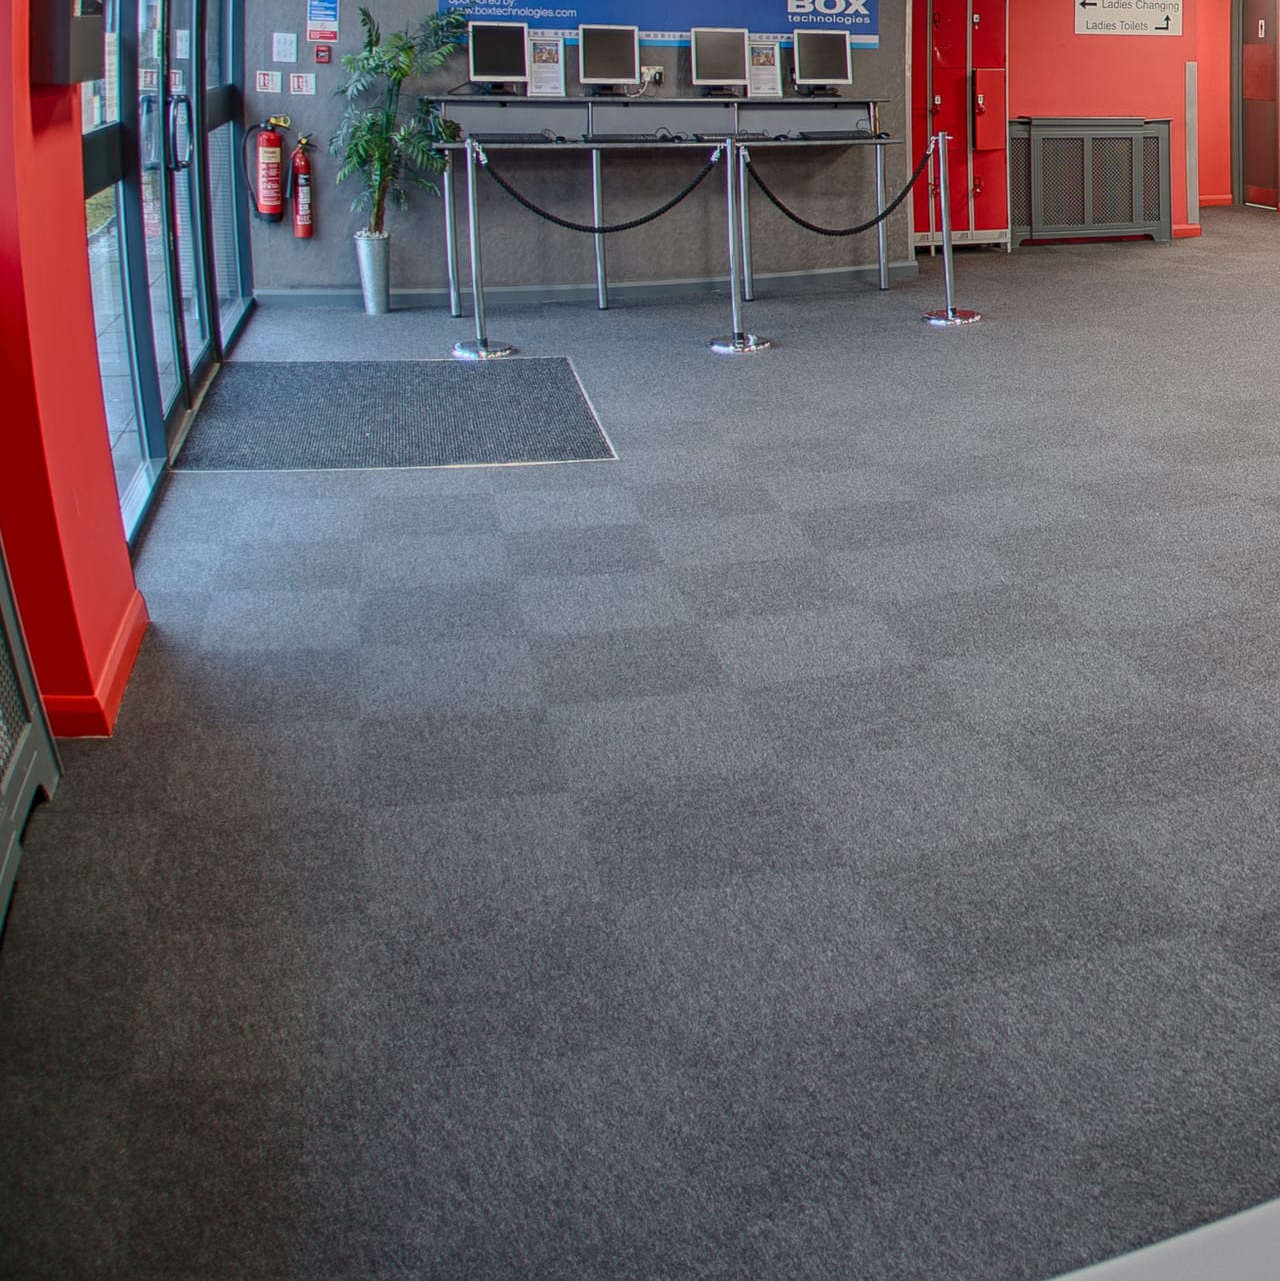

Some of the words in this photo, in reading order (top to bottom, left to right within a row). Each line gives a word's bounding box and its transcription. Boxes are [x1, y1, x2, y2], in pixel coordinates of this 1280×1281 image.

[1101, 0, 1133, 9] Ladies
[1135, 0, 1180, 12] Changing
[787, 14, 871, 25] technologies
[1086, 20, 1117, 30] Ladies
[1120, 21, 1149, 31] Toilets
